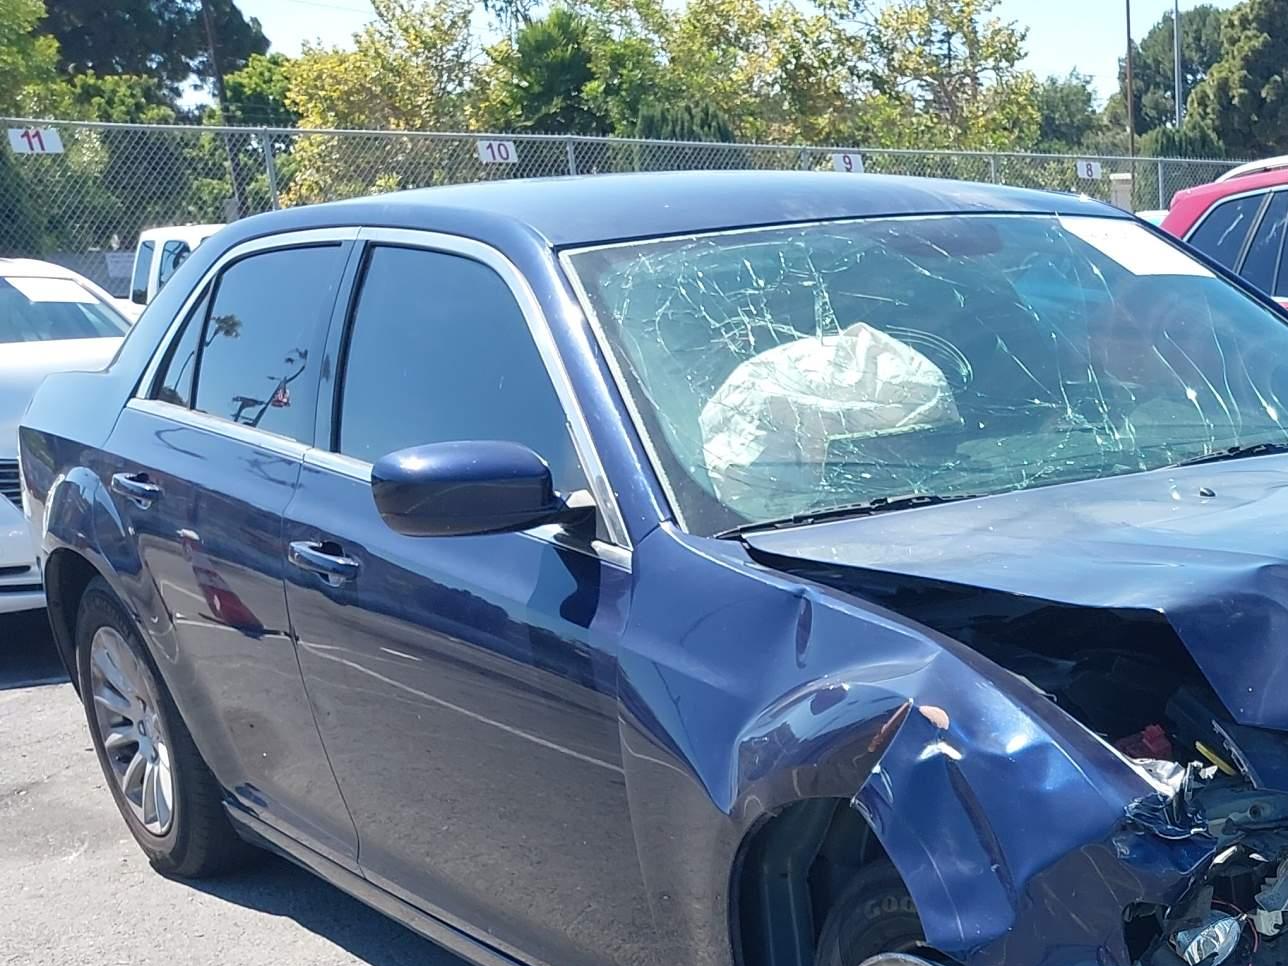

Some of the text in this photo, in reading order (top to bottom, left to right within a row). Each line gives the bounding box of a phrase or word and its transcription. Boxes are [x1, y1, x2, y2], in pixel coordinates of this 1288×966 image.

[20, 129, 46, 151] 11
[486, 142, 510, 161] 10
[842, 155, 853, 173] 9
[1086, 163, 1094, 178] 8
